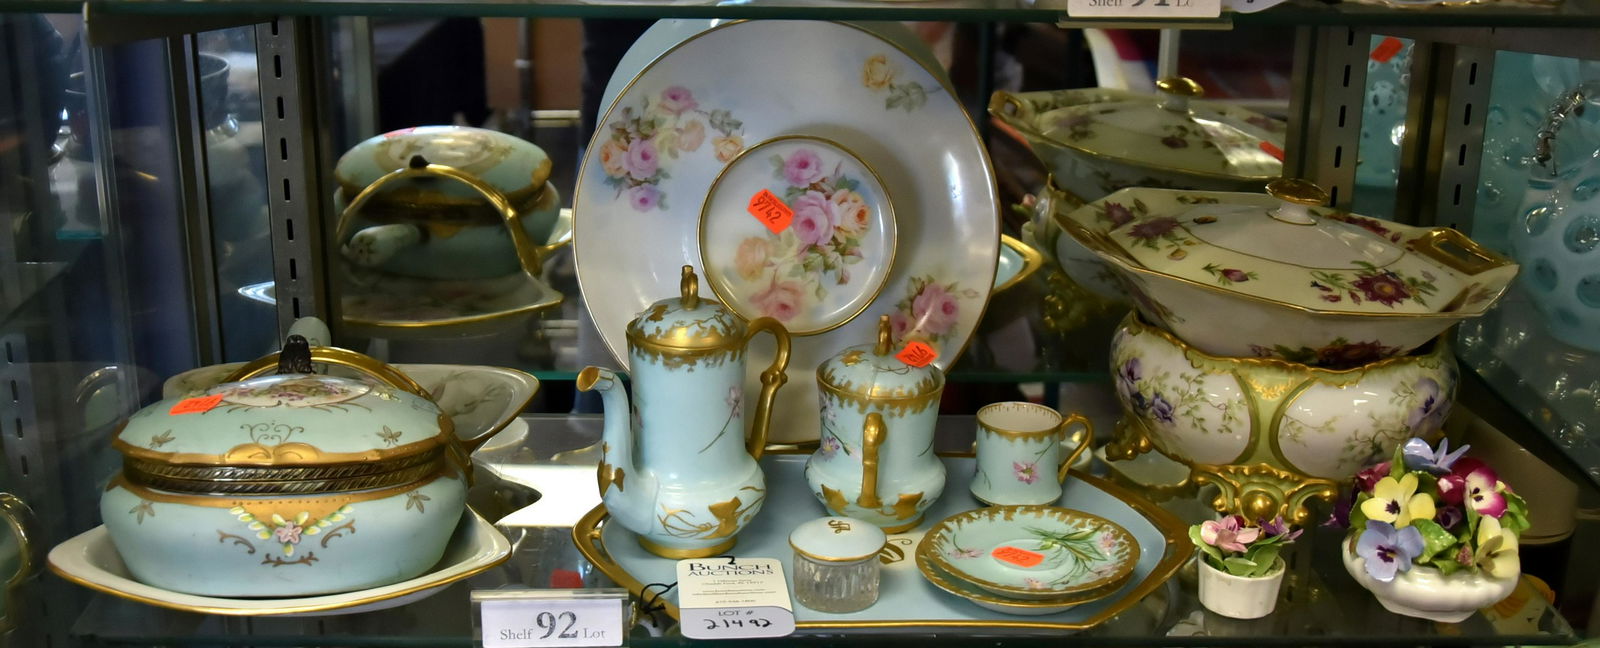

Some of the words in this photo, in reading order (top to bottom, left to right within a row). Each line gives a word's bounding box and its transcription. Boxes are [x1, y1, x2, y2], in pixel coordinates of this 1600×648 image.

[689, 563, 770, 571] BUNCH
[688, 569, 774, 577] AUCTIONS
[500, 628, 533, 640] Shelf
[536, 611, 578, 639] 92
[583, 627, 606, 639] Lot
[703, 619, 773, 630] 21492
